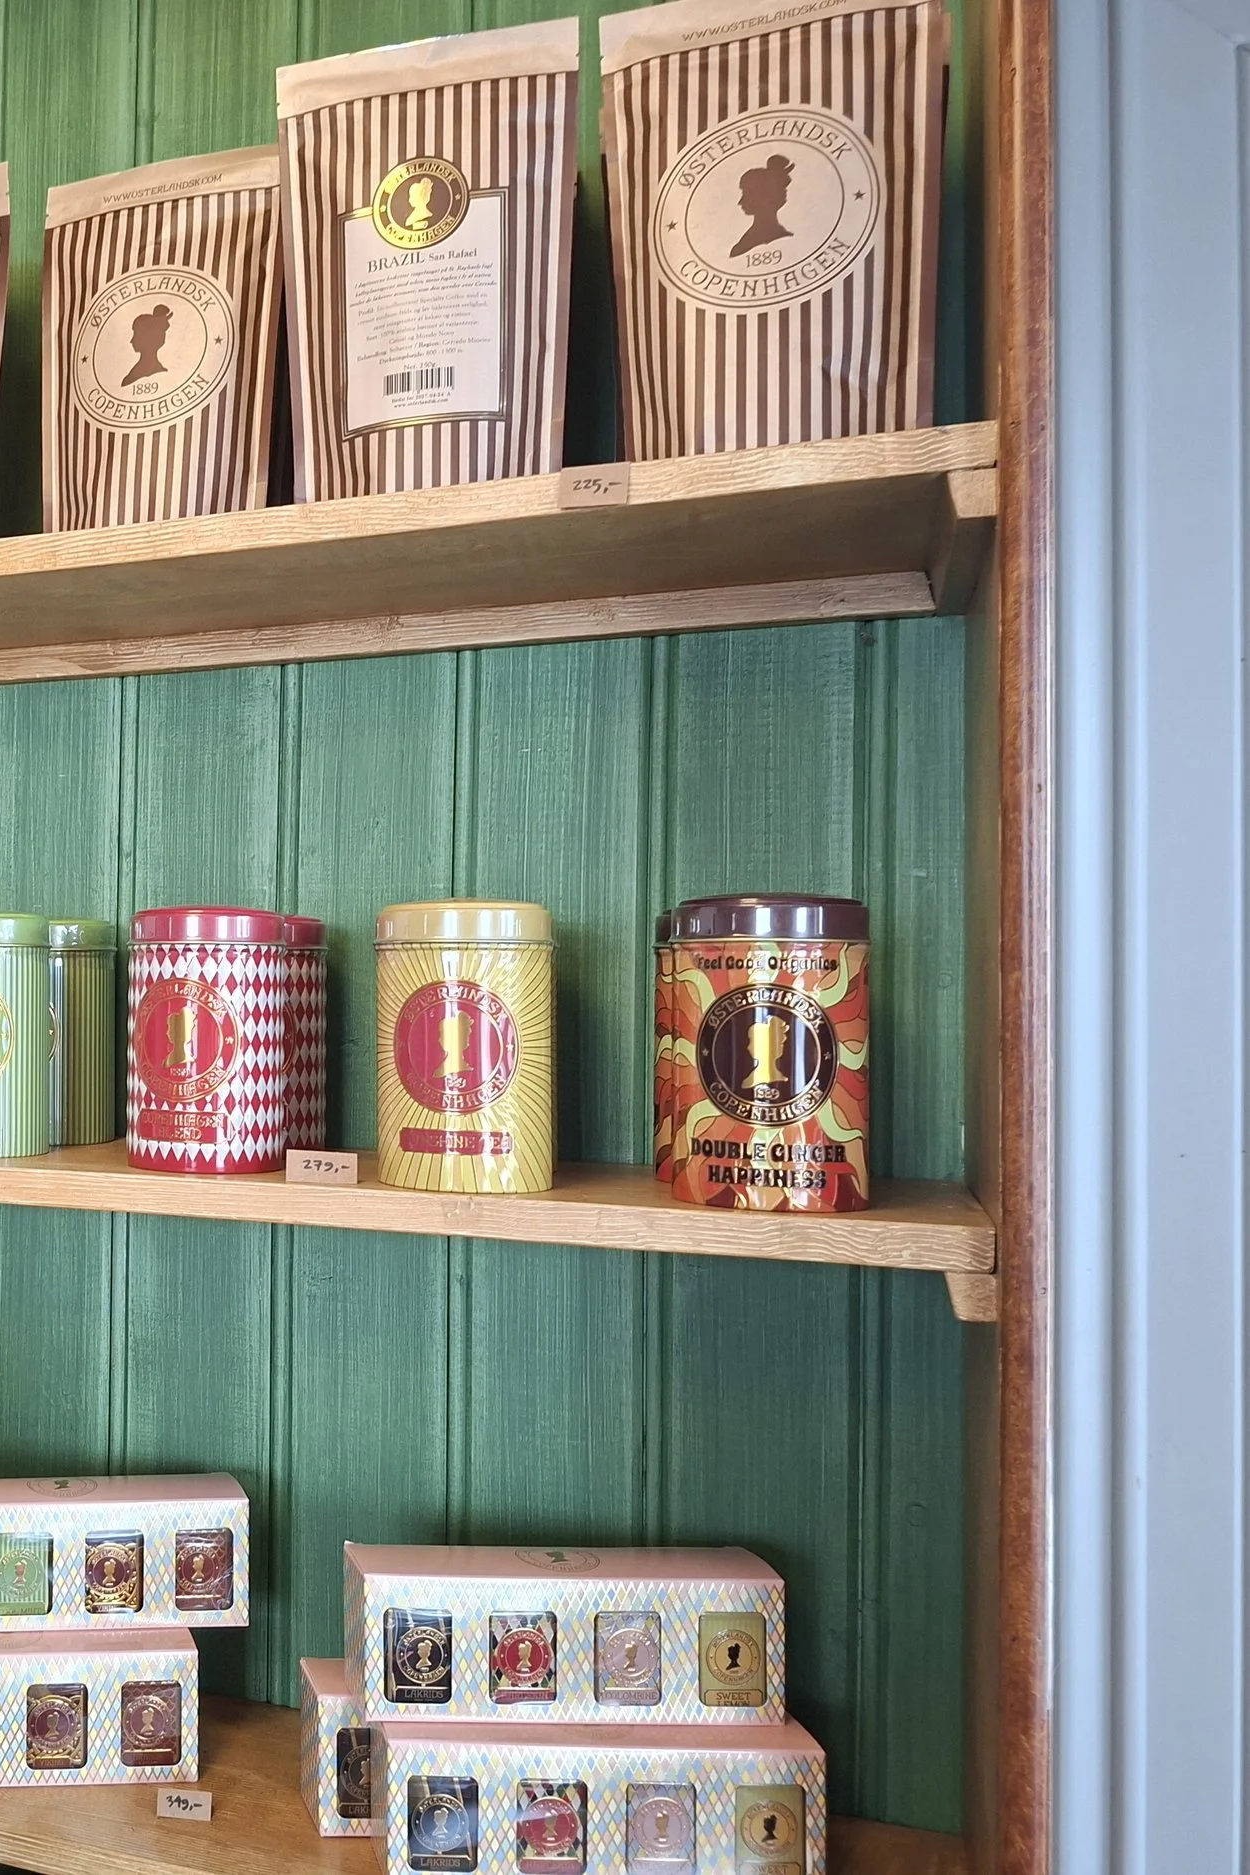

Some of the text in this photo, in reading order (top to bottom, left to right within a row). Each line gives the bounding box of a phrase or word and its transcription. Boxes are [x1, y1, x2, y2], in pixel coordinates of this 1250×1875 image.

[678, 119, 853, 188] ØSTERLANDSK
[367, 251, 426, 274] BRAZIL
[428, 252, 445, 262] San
[448, 247, 477, 260] Rafael
[680, 236, 851, 298] COPENHAGEN
[746, 250, 783, 268] 1889
[90, 276, 217, 330] ØSTERLANDSK
[87, 374, 211, 421] COPENHAGEN
[132, 382, 159, 396] 1889
[572, 478, 623, 495] 225,-
[696, 955, 839, 972] Feel Good Organics
[708, 1081, 825, 1122] COPENHAGEN
[690, 1136, 847, 1164] DOUBLE GINGER
[302, 1159, 350, 1174] 279,-
[707, 1164, 828, 1190] HAPPINESS
[404, 1689, 444, 1699] LAKRIDS
[716, 1691, 752, 1701] SWEET
[165, 1795, 203, 1811] 349,-
[420, 1856, 461, 1867] LAKRIDS
